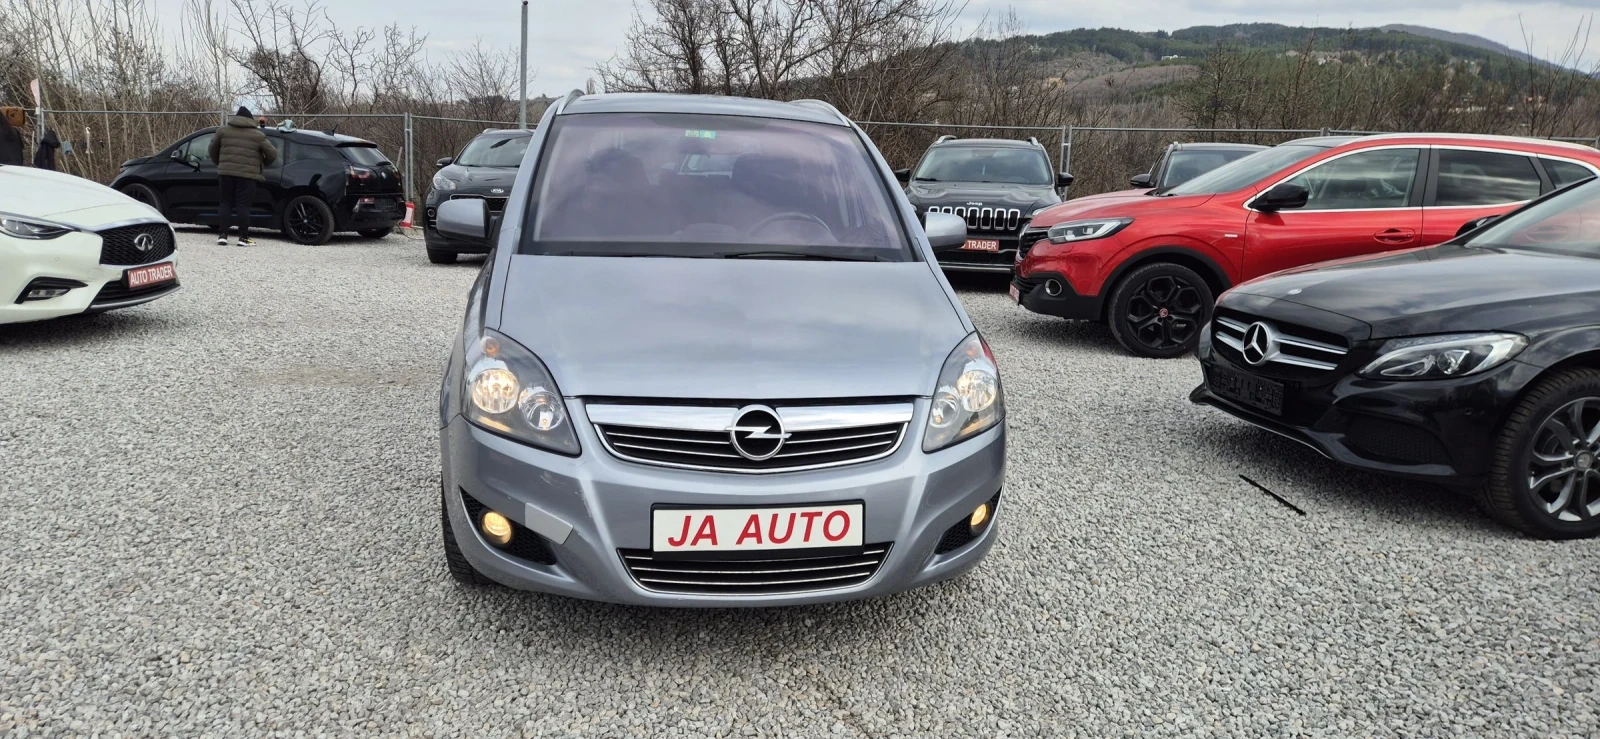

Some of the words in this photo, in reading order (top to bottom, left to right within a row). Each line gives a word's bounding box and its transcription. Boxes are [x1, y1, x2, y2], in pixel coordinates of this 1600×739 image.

[967, 240, 997, 250] TRADER
[130, 270, 148, 285] AUTO
[148, 265, 173, 281] TRADER
[667, 515, 718, 547] JA
[735, 510, 851, 545] AUTO
